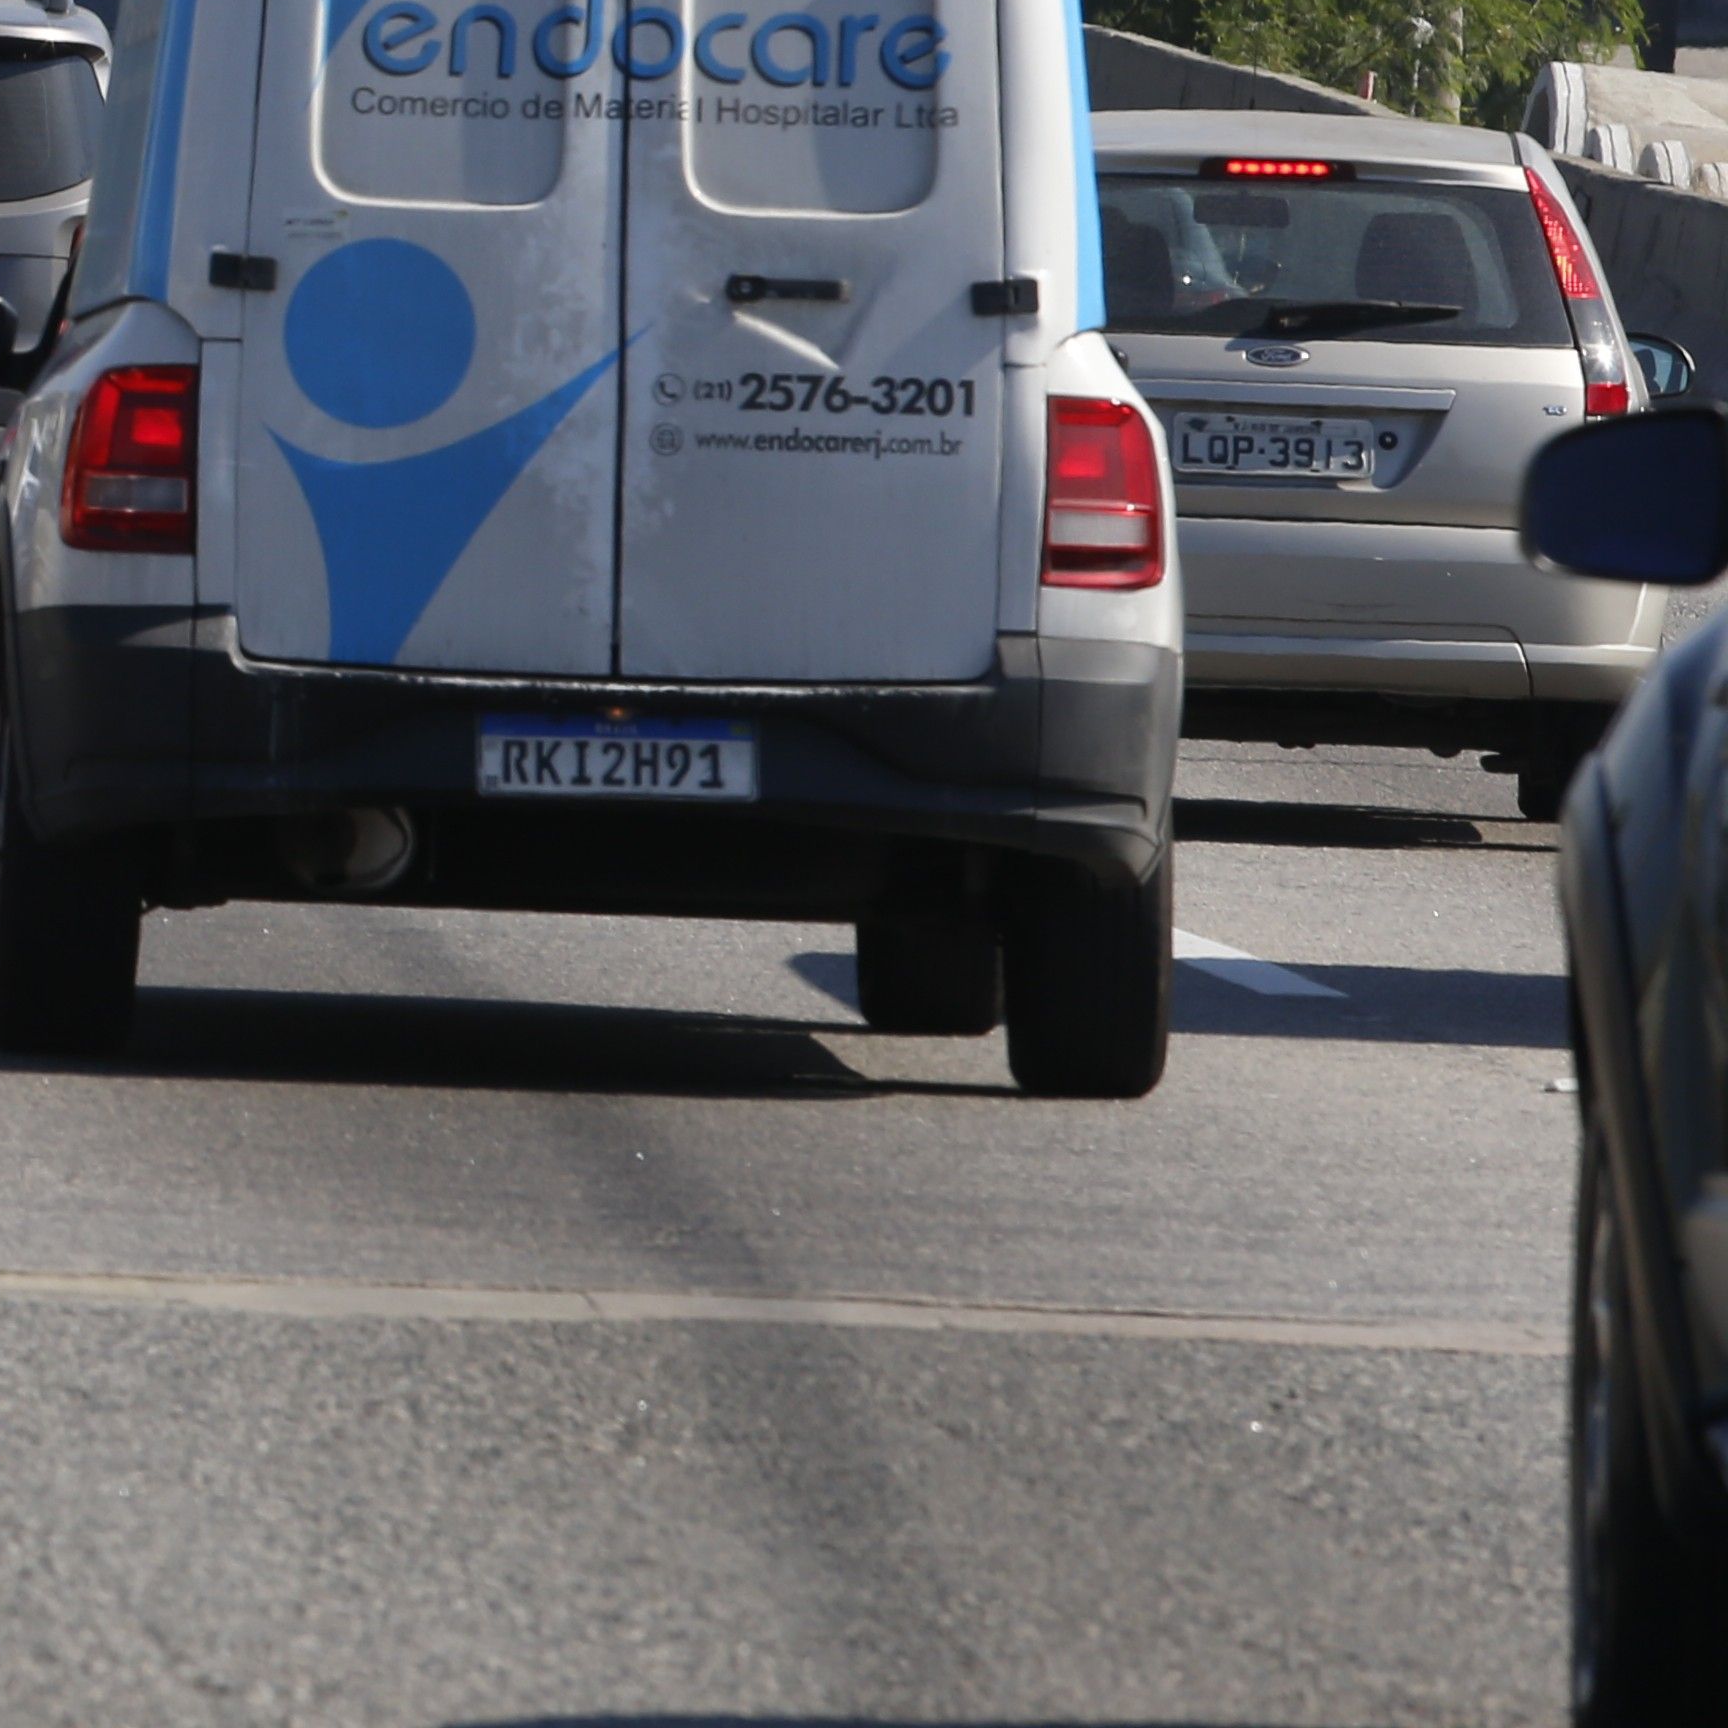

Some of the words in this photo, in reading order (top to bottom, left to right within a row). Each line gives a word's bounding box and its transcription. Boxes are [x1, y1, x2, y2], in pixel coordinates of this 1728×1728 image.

[351, 87, 510, 119] Comercio
[521, 92, 564, 120] de
[574, 93, 703, 123] Material
[716, 98, 885, 131] Hospitalar
[694, 379, 733, 401] (21)
[738, 372, 976, 417] 2576-3201
[695, 427, 963, 460] www.endocarerj.com.br
[501, 739, 725, 789] RKI2H91
